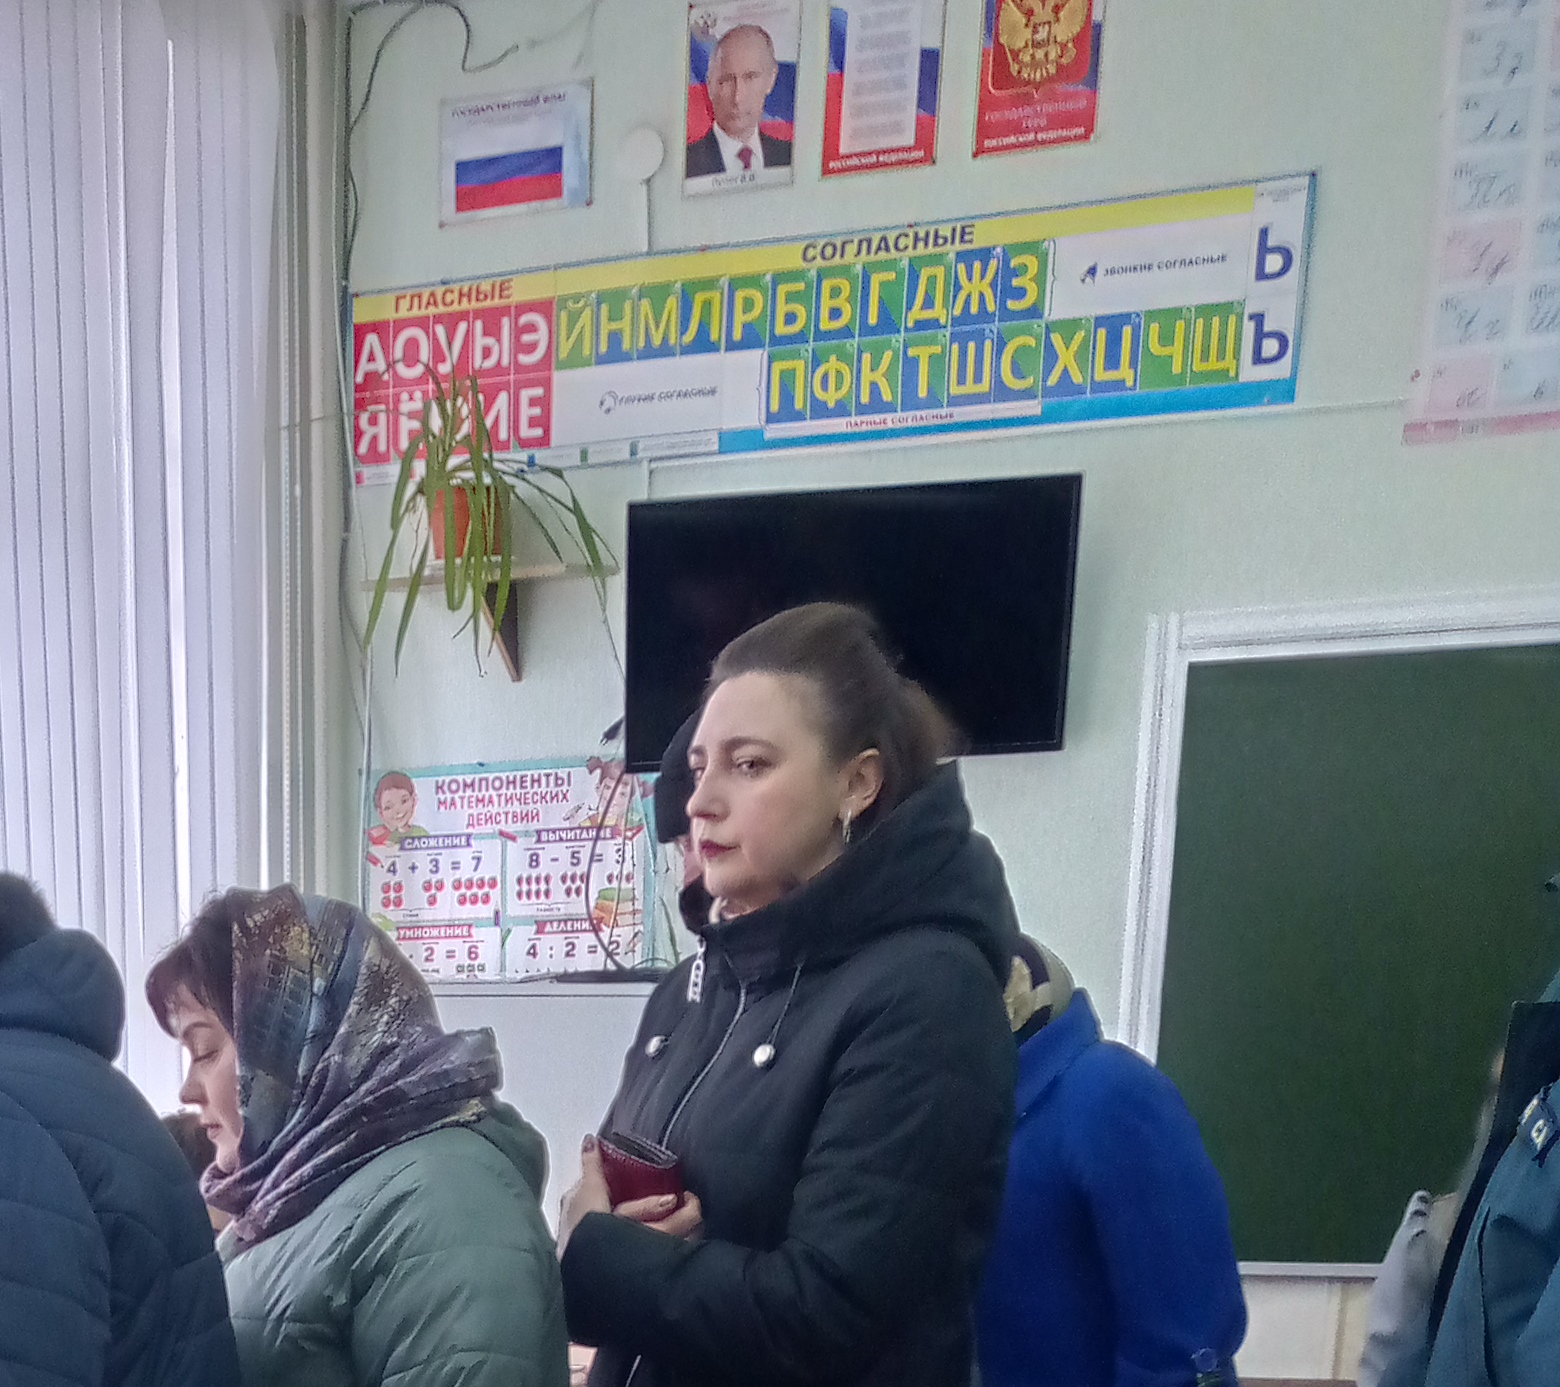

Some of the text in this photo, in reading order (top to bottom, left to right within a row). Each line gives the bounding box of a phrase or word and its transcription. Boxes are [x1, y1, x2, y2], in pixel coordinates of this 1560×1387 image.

[801, 224, 975, 263] СОГЛАСНЫЕ
[1157, 253, 1228, 270] СОГЛАСНЫЕ
[1255, 226, 1294, 282] Ь
[394, 278, 514, 314] ГЛАСНЫЕ
[845, 412, 955, 429] ПАРНЫЕ СОГЛАСНЫЕ
[435, 771, 572, 795] КОМПОНЕНТЫ
[437, 789, 570, 811] МАТЕМАТИЧЕСКИХ
[466, 808, 541, 829] ДЕЙСТВИЙ
[405, 837, 468, 849] СЛОЖЕНИЕ
[386, 860, 398, 876] 4
[429, 858, 440, 875] 3
[471, 855, 483, 872] 7
[528, 852, 540, 868] 8
[570, 850, 581, 867] 5
[399, 926, 469, 938] УМНОЖЕНИЕ
[545, 920, 595, 932] ДЕЛЕНИ
[467, 945, 480, 960] 6
[526, 943, 538, 959] 4
[565, 941, 576, 957] 2
